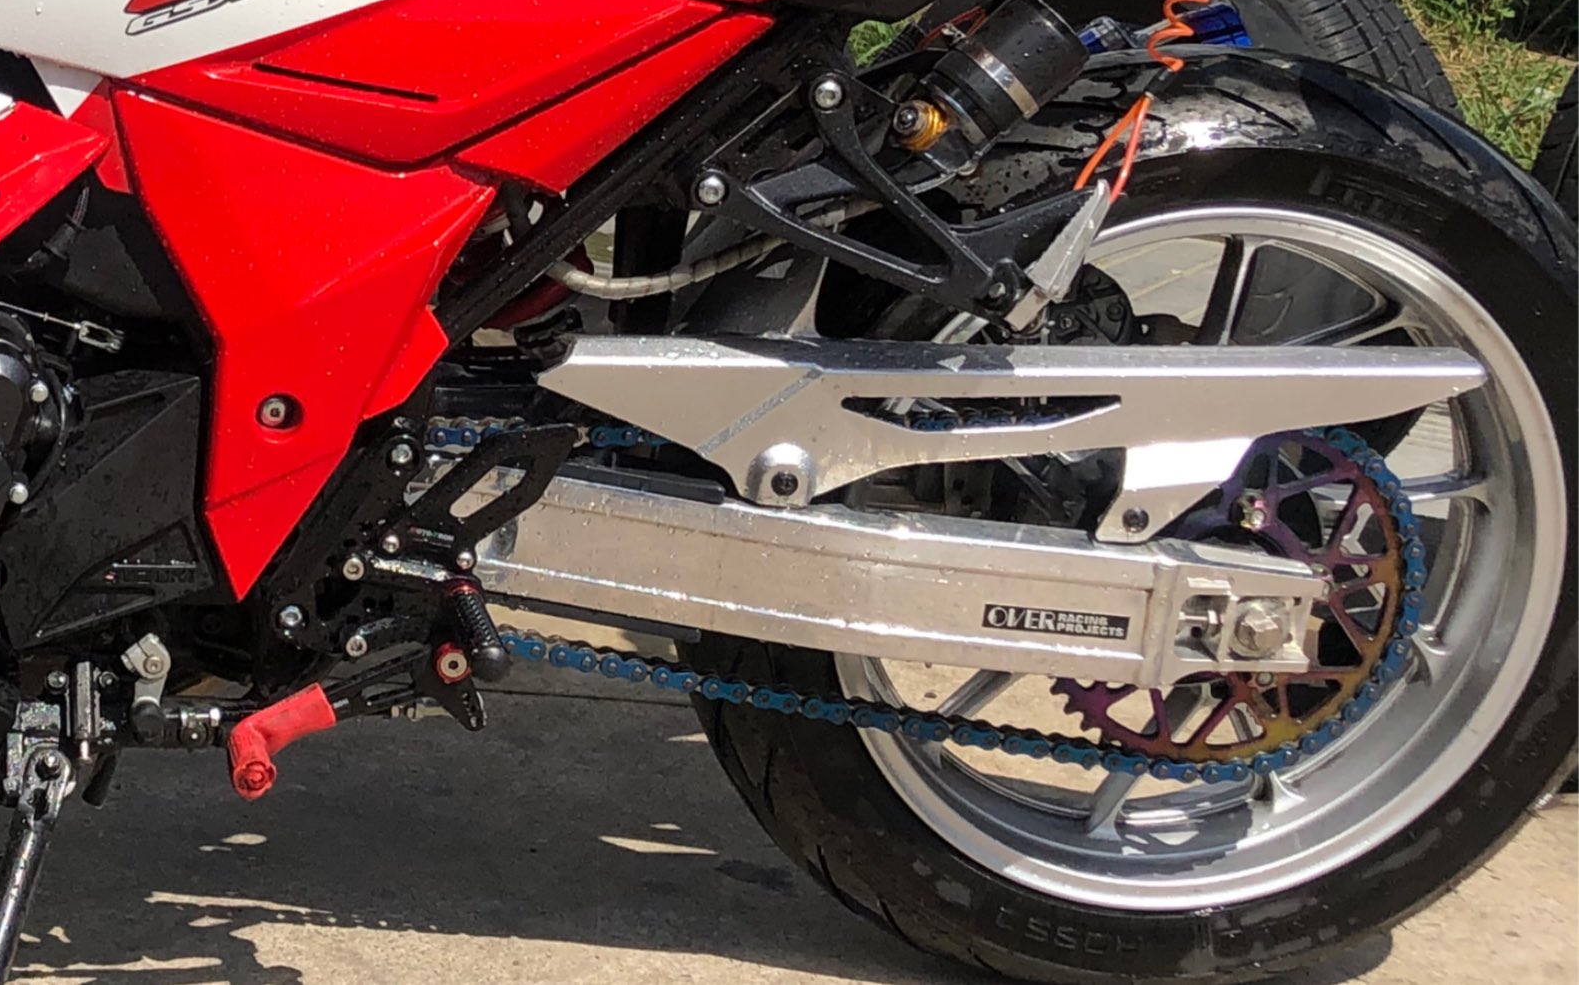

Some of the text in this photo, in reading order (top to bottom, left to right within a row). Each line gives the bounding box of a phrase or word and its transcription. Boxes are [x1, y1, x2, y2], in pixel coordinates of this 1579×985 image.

[987, 606, 1056, 632] OVER
[1056, 613, 1109, 626] RACING
[1056, 622, 1125, 638] PROJECTS
